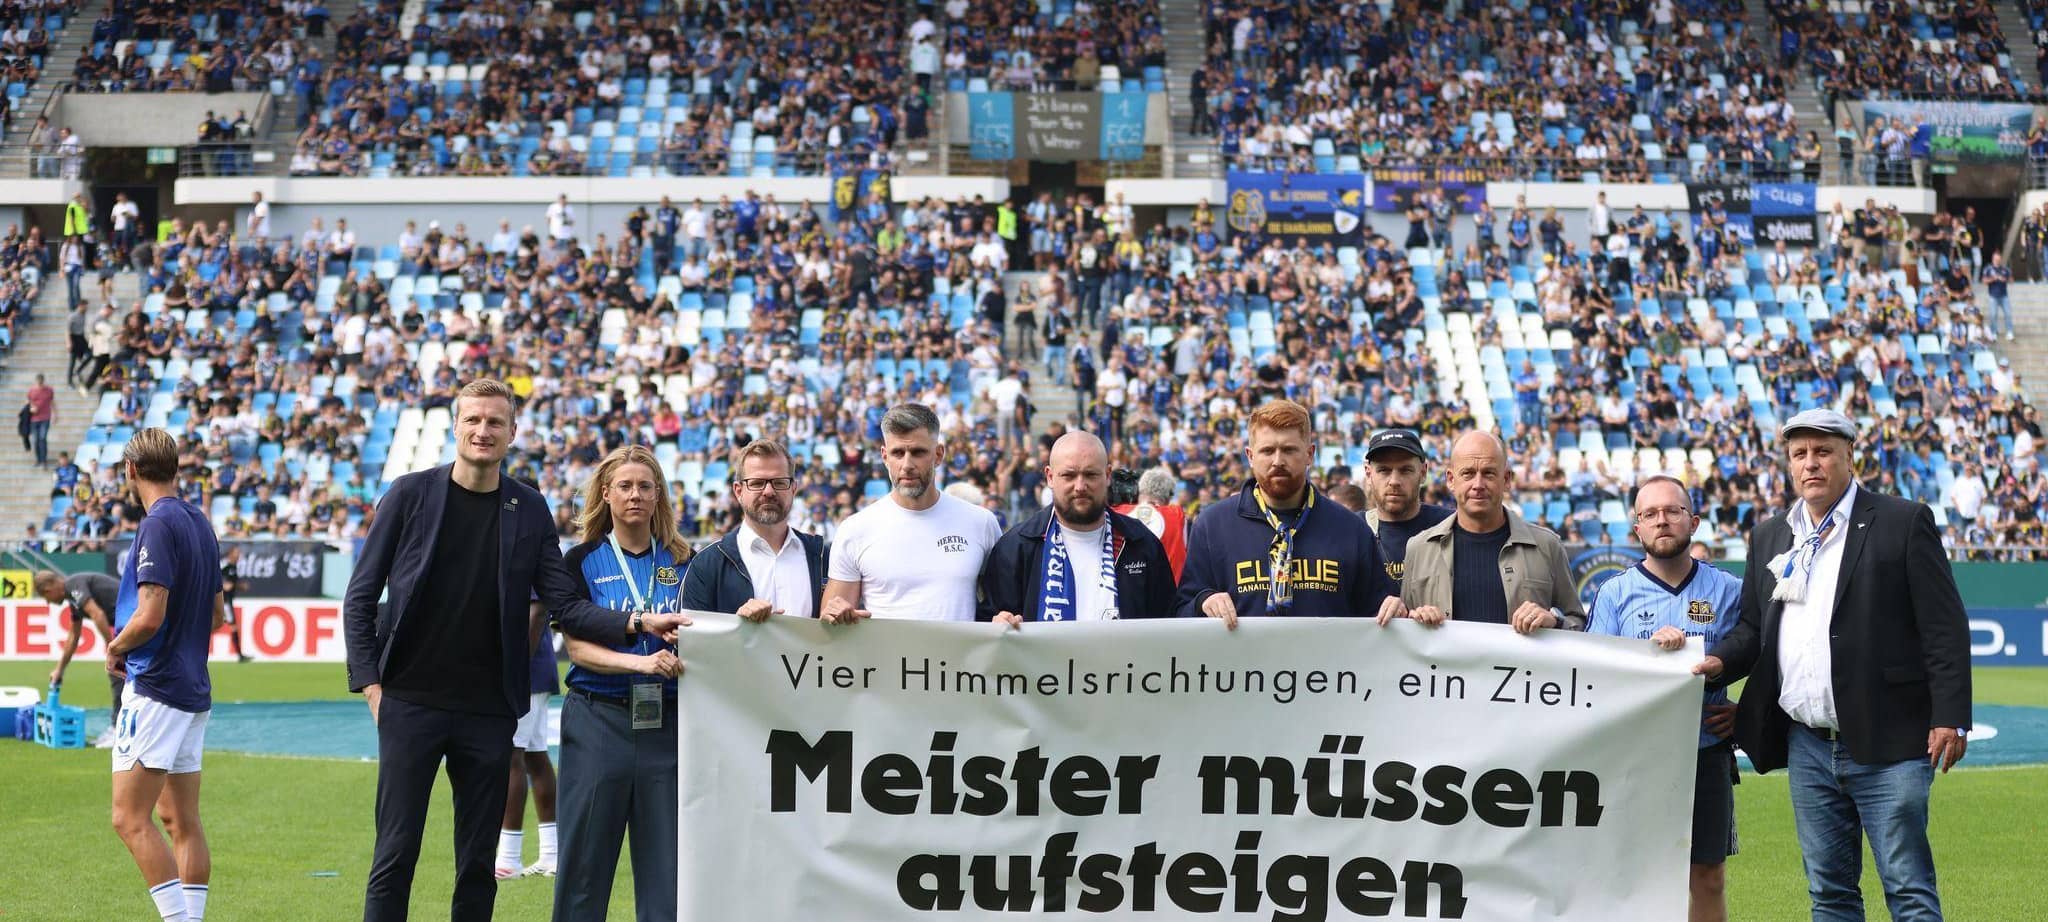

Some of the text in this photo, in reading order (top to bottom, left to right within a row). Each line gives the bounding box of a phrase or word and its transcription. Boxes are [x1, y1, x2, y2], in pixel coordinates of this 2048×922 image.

[1731, 187, 1760, 201] FAN
[937, 535, 969, 547] HERTHA
[1236, 559, 1339, 585] CLQUE
[1237, 582, 1338, 593] CANAILL ARREBRUCK
[779, 653, 1593, 708] Vier Himmelsrichtungen, ein Ziel:
[765, 728, 1606, 828] Meister müssen
[896, 830, 1469, 922] aufsteigen
